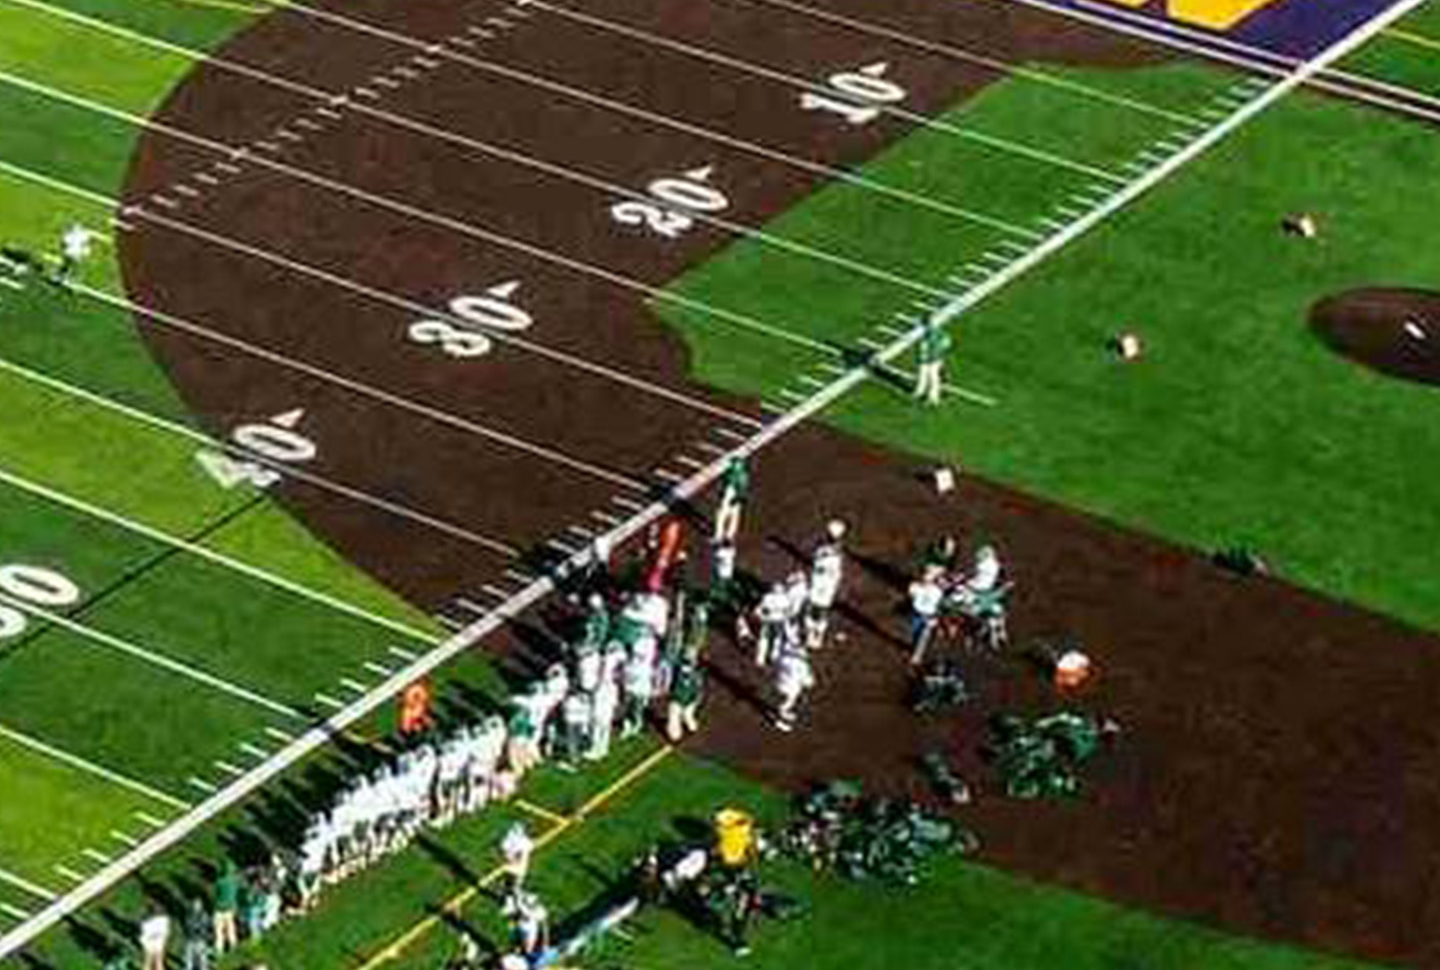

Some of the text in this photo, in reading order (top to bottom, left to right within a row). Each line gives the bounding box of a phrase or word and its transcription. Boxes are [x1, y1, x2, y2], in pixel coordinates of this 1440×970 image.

[799, 72, 906, 124] 10
[611, 179, 728, 238] 20
[408, 296, 533, 357] 30
[195, 423, 317, 488] 40
